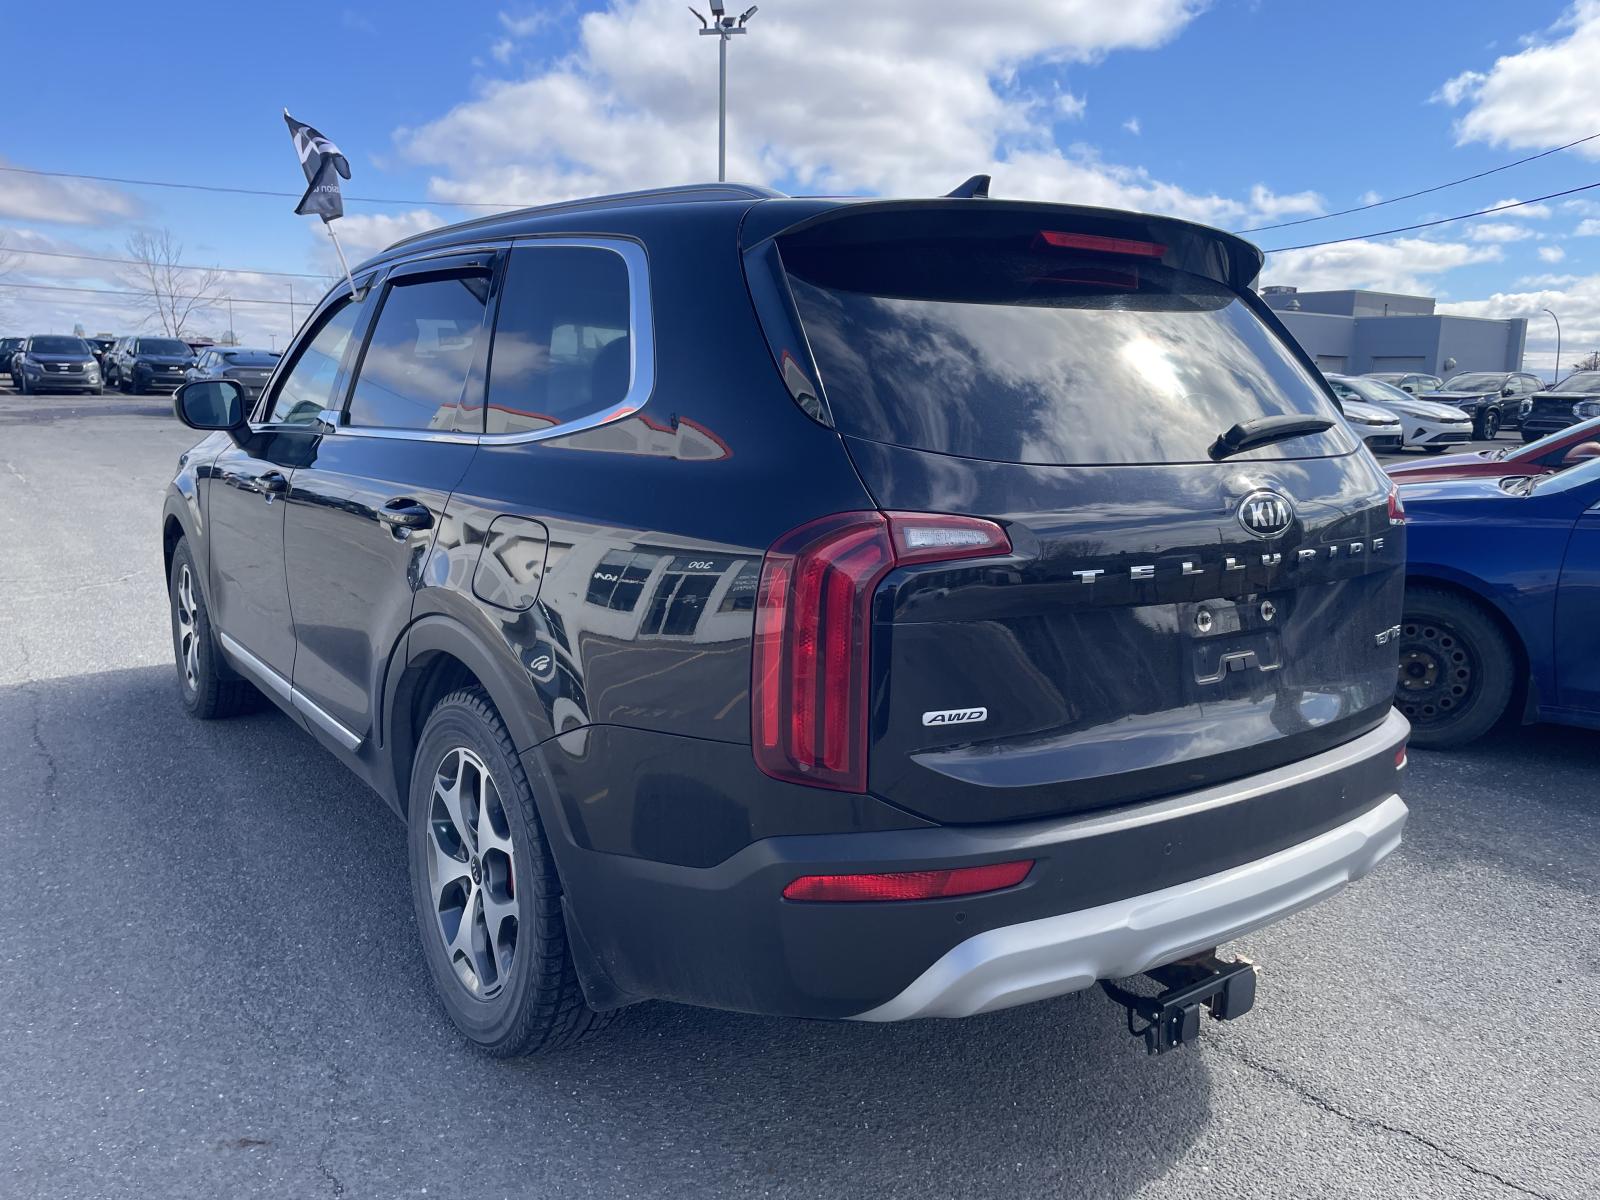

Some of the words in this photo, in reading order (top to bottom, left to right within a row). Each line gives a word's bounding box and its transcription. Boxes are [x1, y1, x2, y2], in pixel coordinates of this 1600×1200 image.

[1249, 500, 1288, 527] KIA
[1072, 538, 1384, 583] TELLURIDE
[927, 711, 984, 724] AWD
